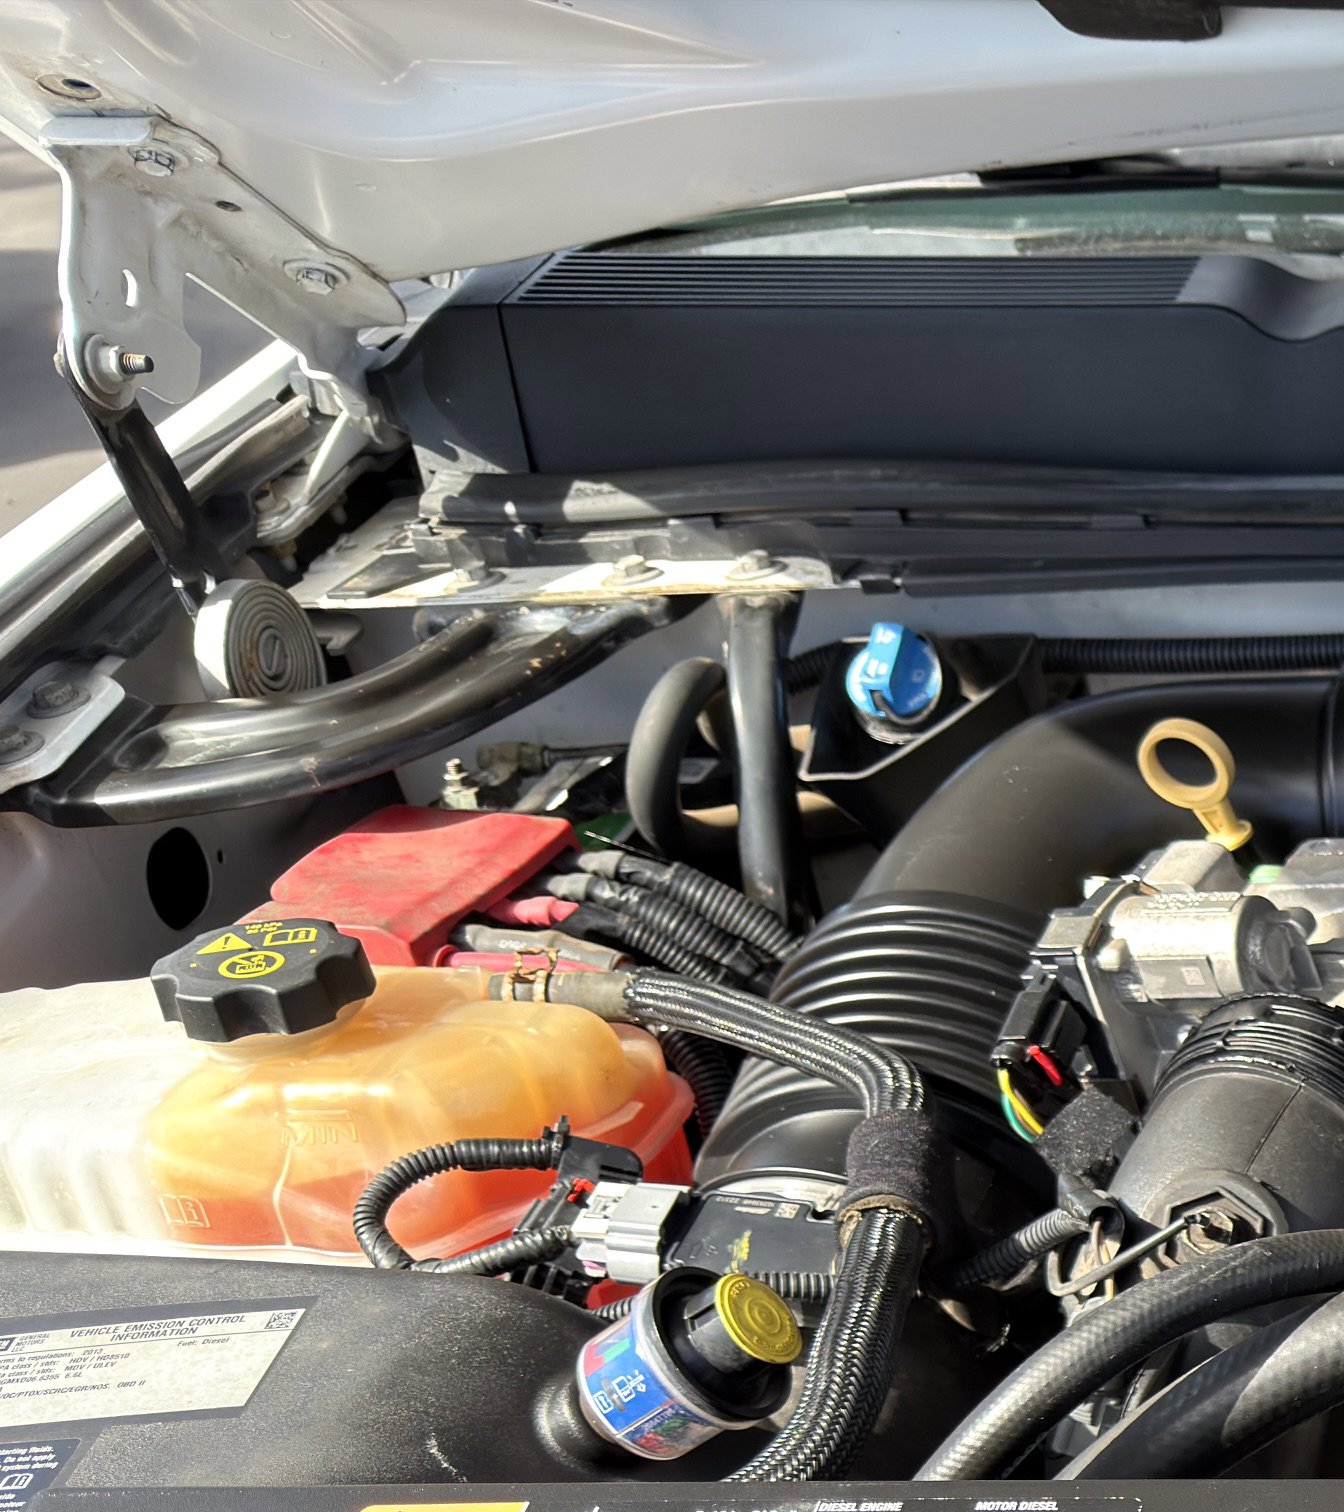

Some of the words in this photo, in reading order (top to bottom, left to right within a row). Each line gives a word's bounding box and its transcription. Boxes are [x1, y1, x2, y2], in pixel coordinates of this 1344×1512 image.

[70, 1326, 120, 1338] VEHICLE
[124, 1321, 185, 1332] EMISSION
[188, 1316, 246, 1327] CONTROL
[110, 1327, 198, 1341] INFORMATION
[202, 1337, 230, 1345] Diesel
[819, 1502, 858, 1511] DIESEL
[860, 1502, 903, 1511] ENGINE
[974, 1502, 1017, 1511] MOTOR
[1018, 1502, 1058, 1511] DIESEL
